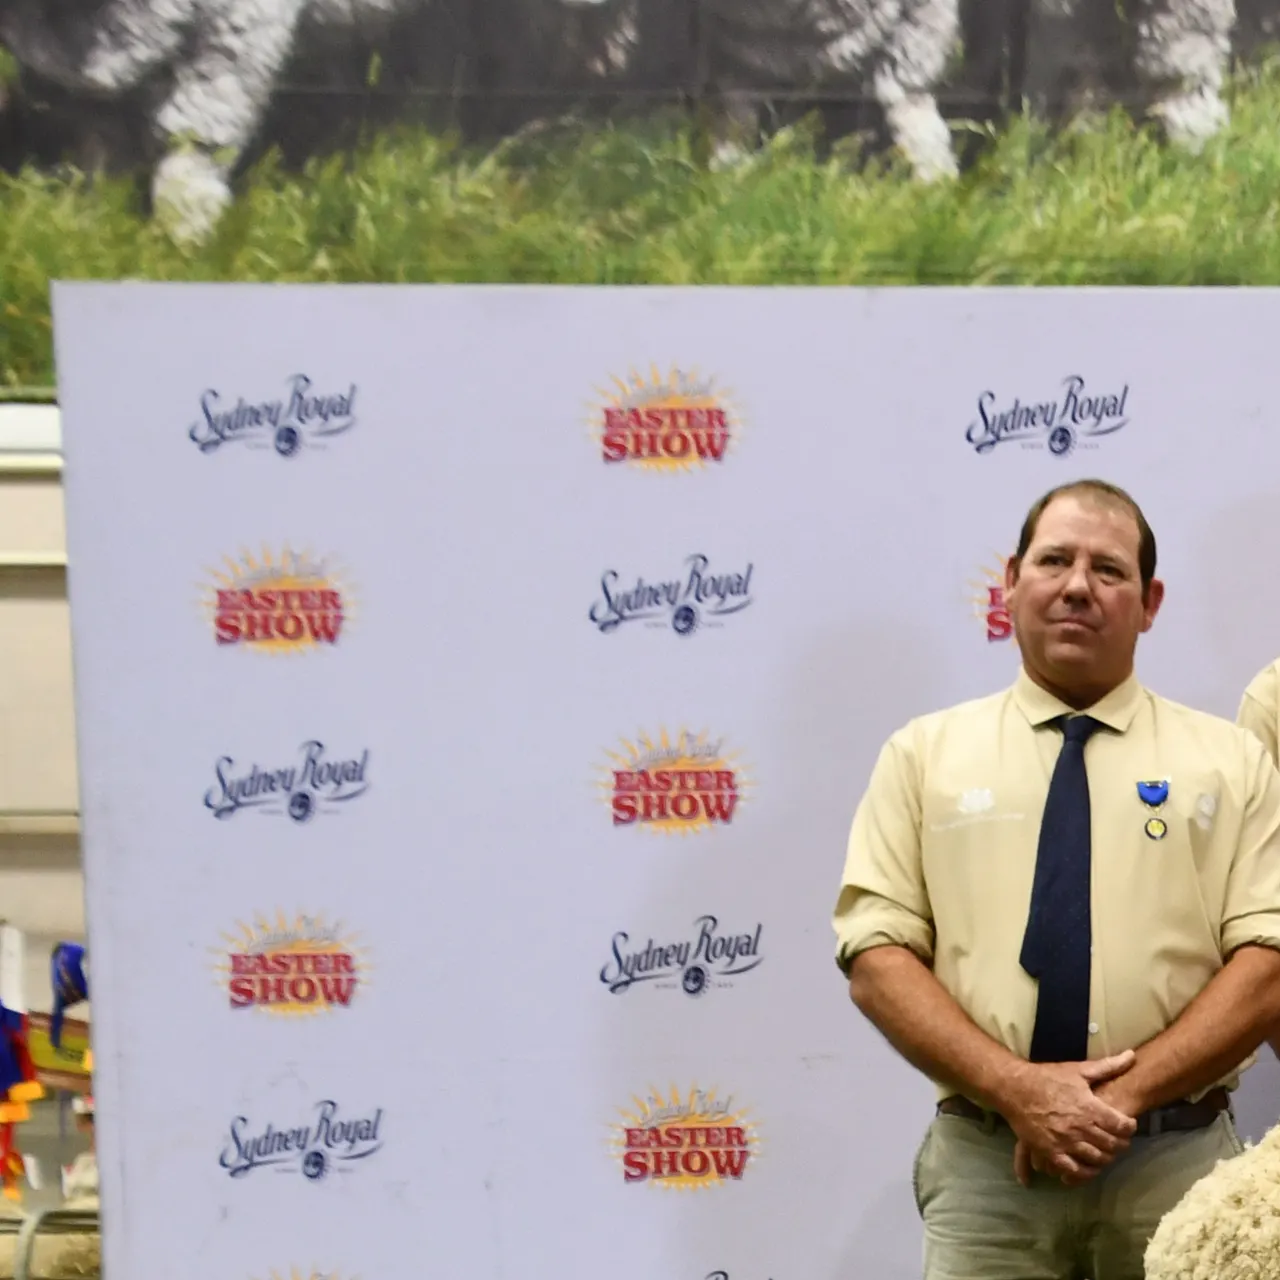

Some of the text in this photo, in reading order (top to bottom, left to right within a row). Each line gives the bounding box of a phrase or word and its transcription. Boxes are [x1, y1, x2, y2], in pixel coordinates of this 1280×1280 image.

[190, 374, 356, 453] Sydney Royal
[604, 408, 726, 429] EASTER
[966, 375, 1129, 453] Sydney Royal
[602, 431, 730, 463] SHOW
[216, 590, 341, 611] EASTER
[590, 554, 753, 632] Sydney Royal
[216, 613, 344, 645] SHOW
[205, 740, 368, 819] Sydney Royal
[613, 771, 736, 791] EASTER
[612, 793, 740, 825] SHOW
[229, 954, 355, 974] EASTER
[600, 915, 762, 993] Sydney Royal
[229, 977, 357, 1007] SHOW
[220, 1101, 382, 1178] Sydney Royal
[624, 1127, 747, 1148] EASTER
[623, 1149, 750, 1182] SHOW
